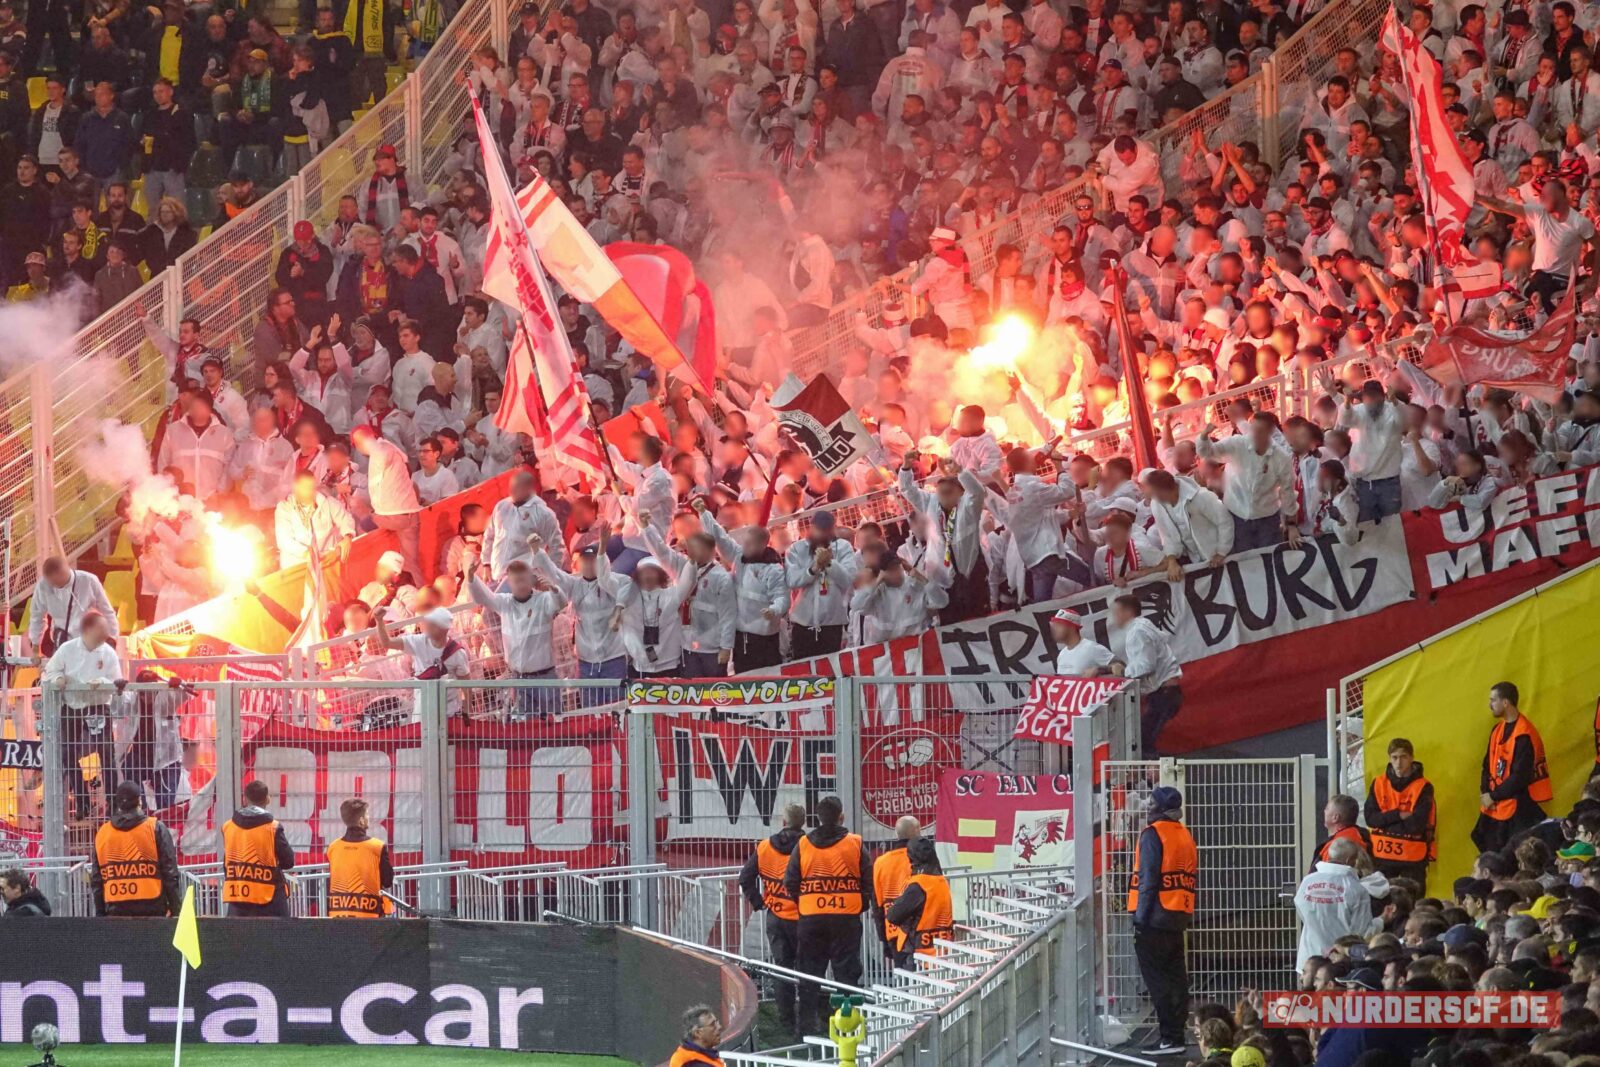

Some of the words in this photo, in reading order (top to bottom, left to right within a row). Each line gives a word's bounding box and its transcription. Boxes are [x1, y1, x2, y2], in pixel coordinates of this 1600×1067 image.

[740, 677, 829, 704] VOLTS
[956, 774, 985, 796] SC
[996, 774, 1038, 796] FAN
[866, 786, 906, 801] IMMER
[1376, 840, 1404, 856] 033
[110, 882, 138, 896] 030
[816, 896, 846, 909] 041
[0, 964, 543, 1049] nt-a-car
